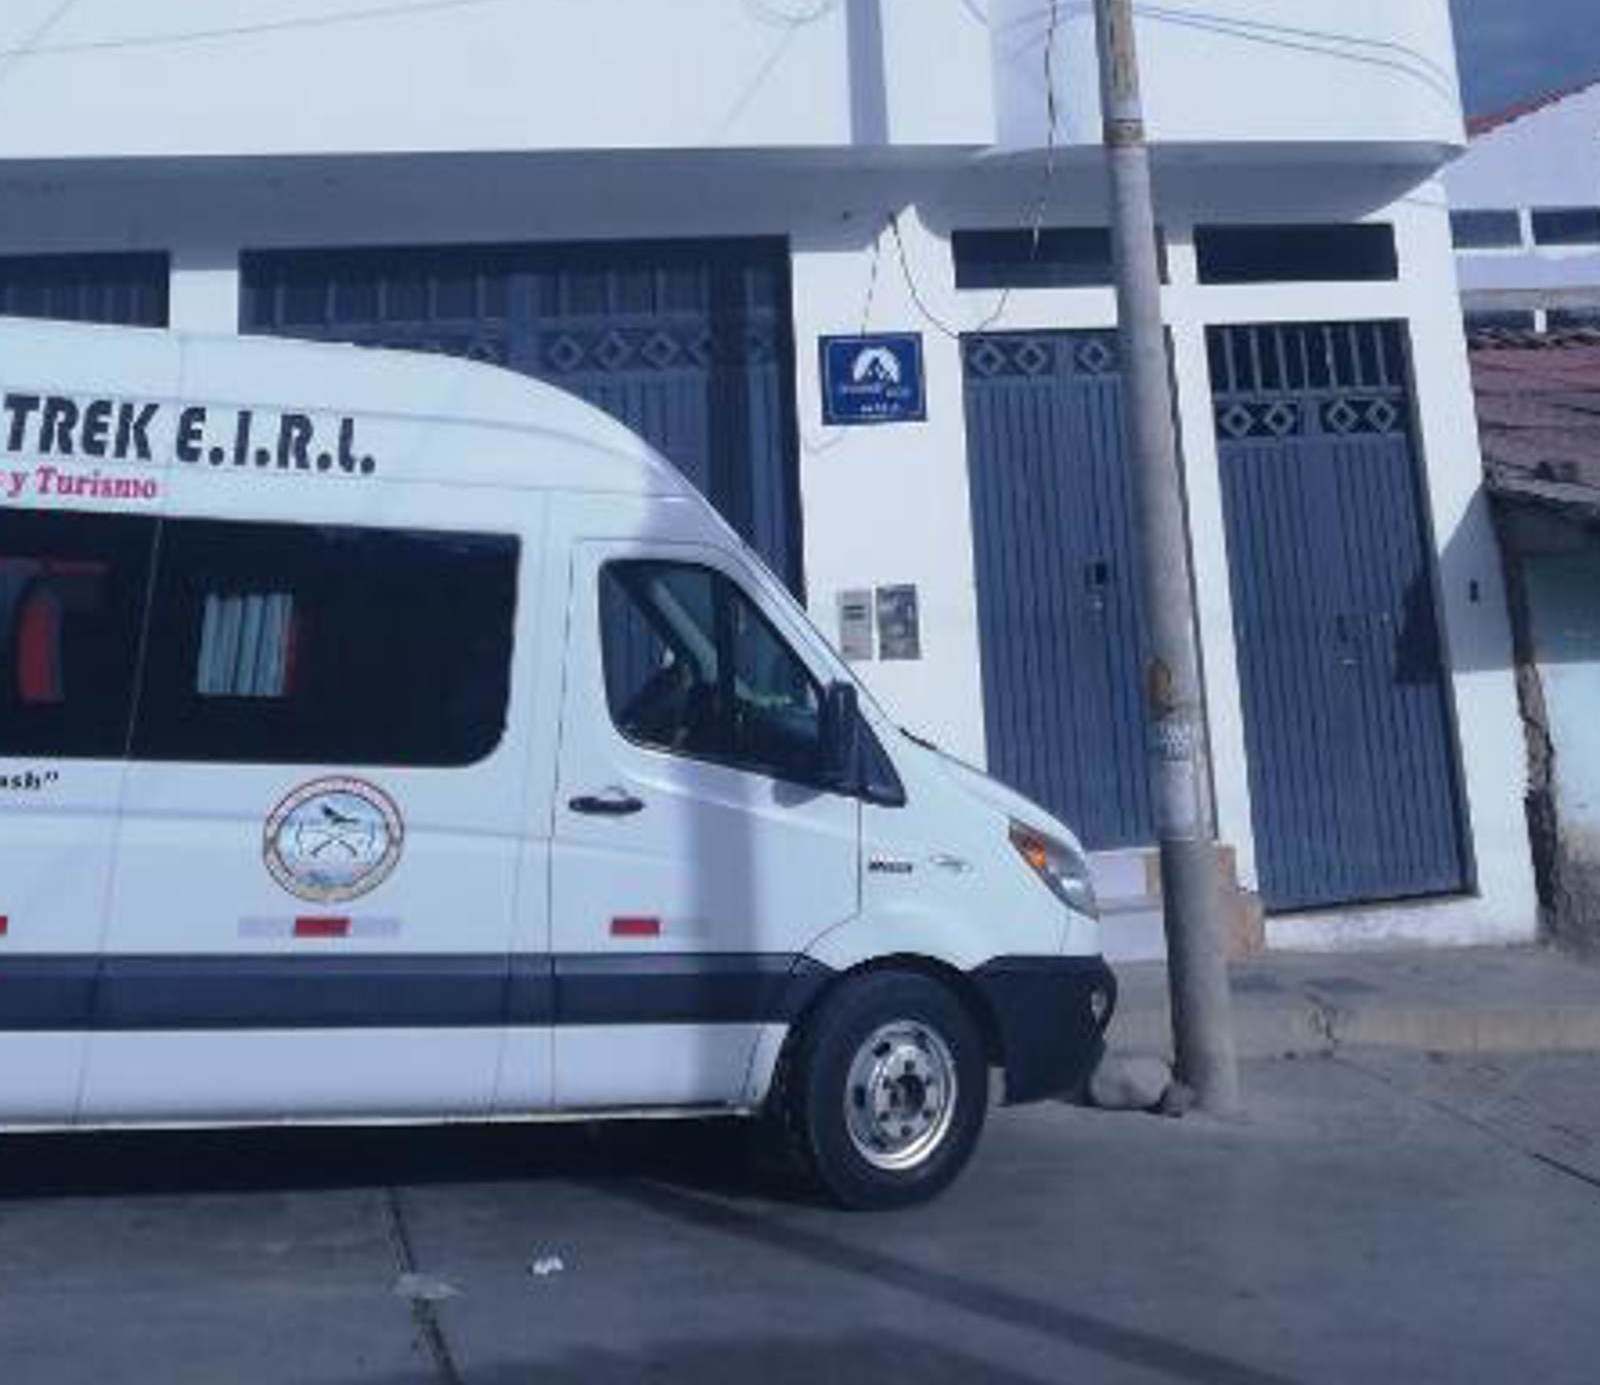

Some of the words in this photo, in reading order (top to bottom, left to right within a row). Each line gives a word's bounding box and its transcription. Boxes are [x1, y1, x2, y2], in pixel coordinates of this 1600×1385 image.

[3, 392, 159, 460] TREK
[175, 406, 375, 476] E.I.R.L.
[7, 471, 29, 498] y
[36, 466, 157, 499] Turismo
